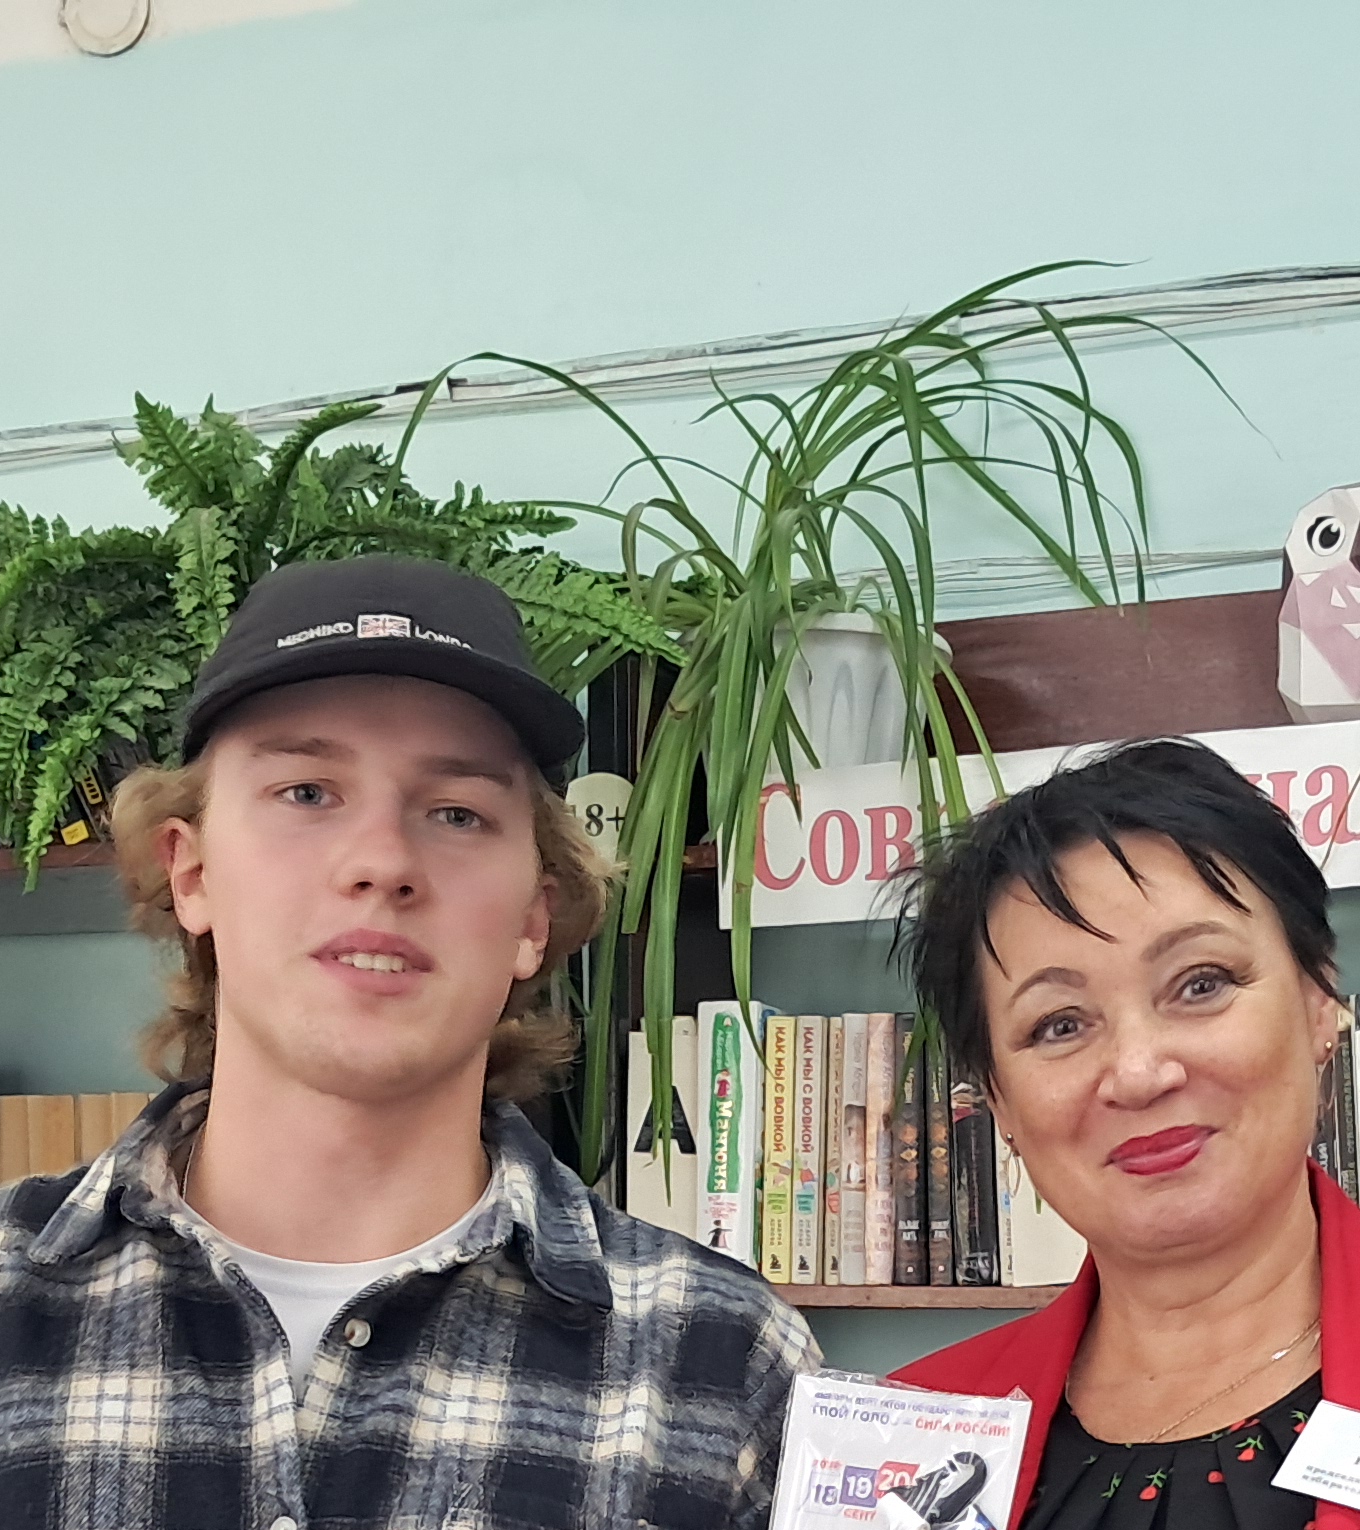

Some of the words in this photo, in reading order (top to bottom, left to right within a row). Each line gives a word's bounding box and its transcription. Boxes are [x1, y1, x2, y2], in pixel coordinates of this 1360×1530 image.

[415, 625, 473, 650] LOND
[774, 1026, 787, 1052] КАК
[802, 1026, 815, 1052] КАК
[775, 1057, 786, 1080] МЫ
[802, 1057, 814, 1080] МЫ
[775, 1083, 786, 1093] С
[802, 1083, 814, 1094] С
[633, 1085, 697, 1154] А
[774, 1096, 787, 1153] ВОВКОЙ
[801, 1096, 815, 1153] ВОВКОЙ
[713, 1100, 733, 1192] Манюня
[813, 1482, 839, 1507] 18
[844, 1473, 874, 1499] 19
[877, 1469, 913, 1492] 20
